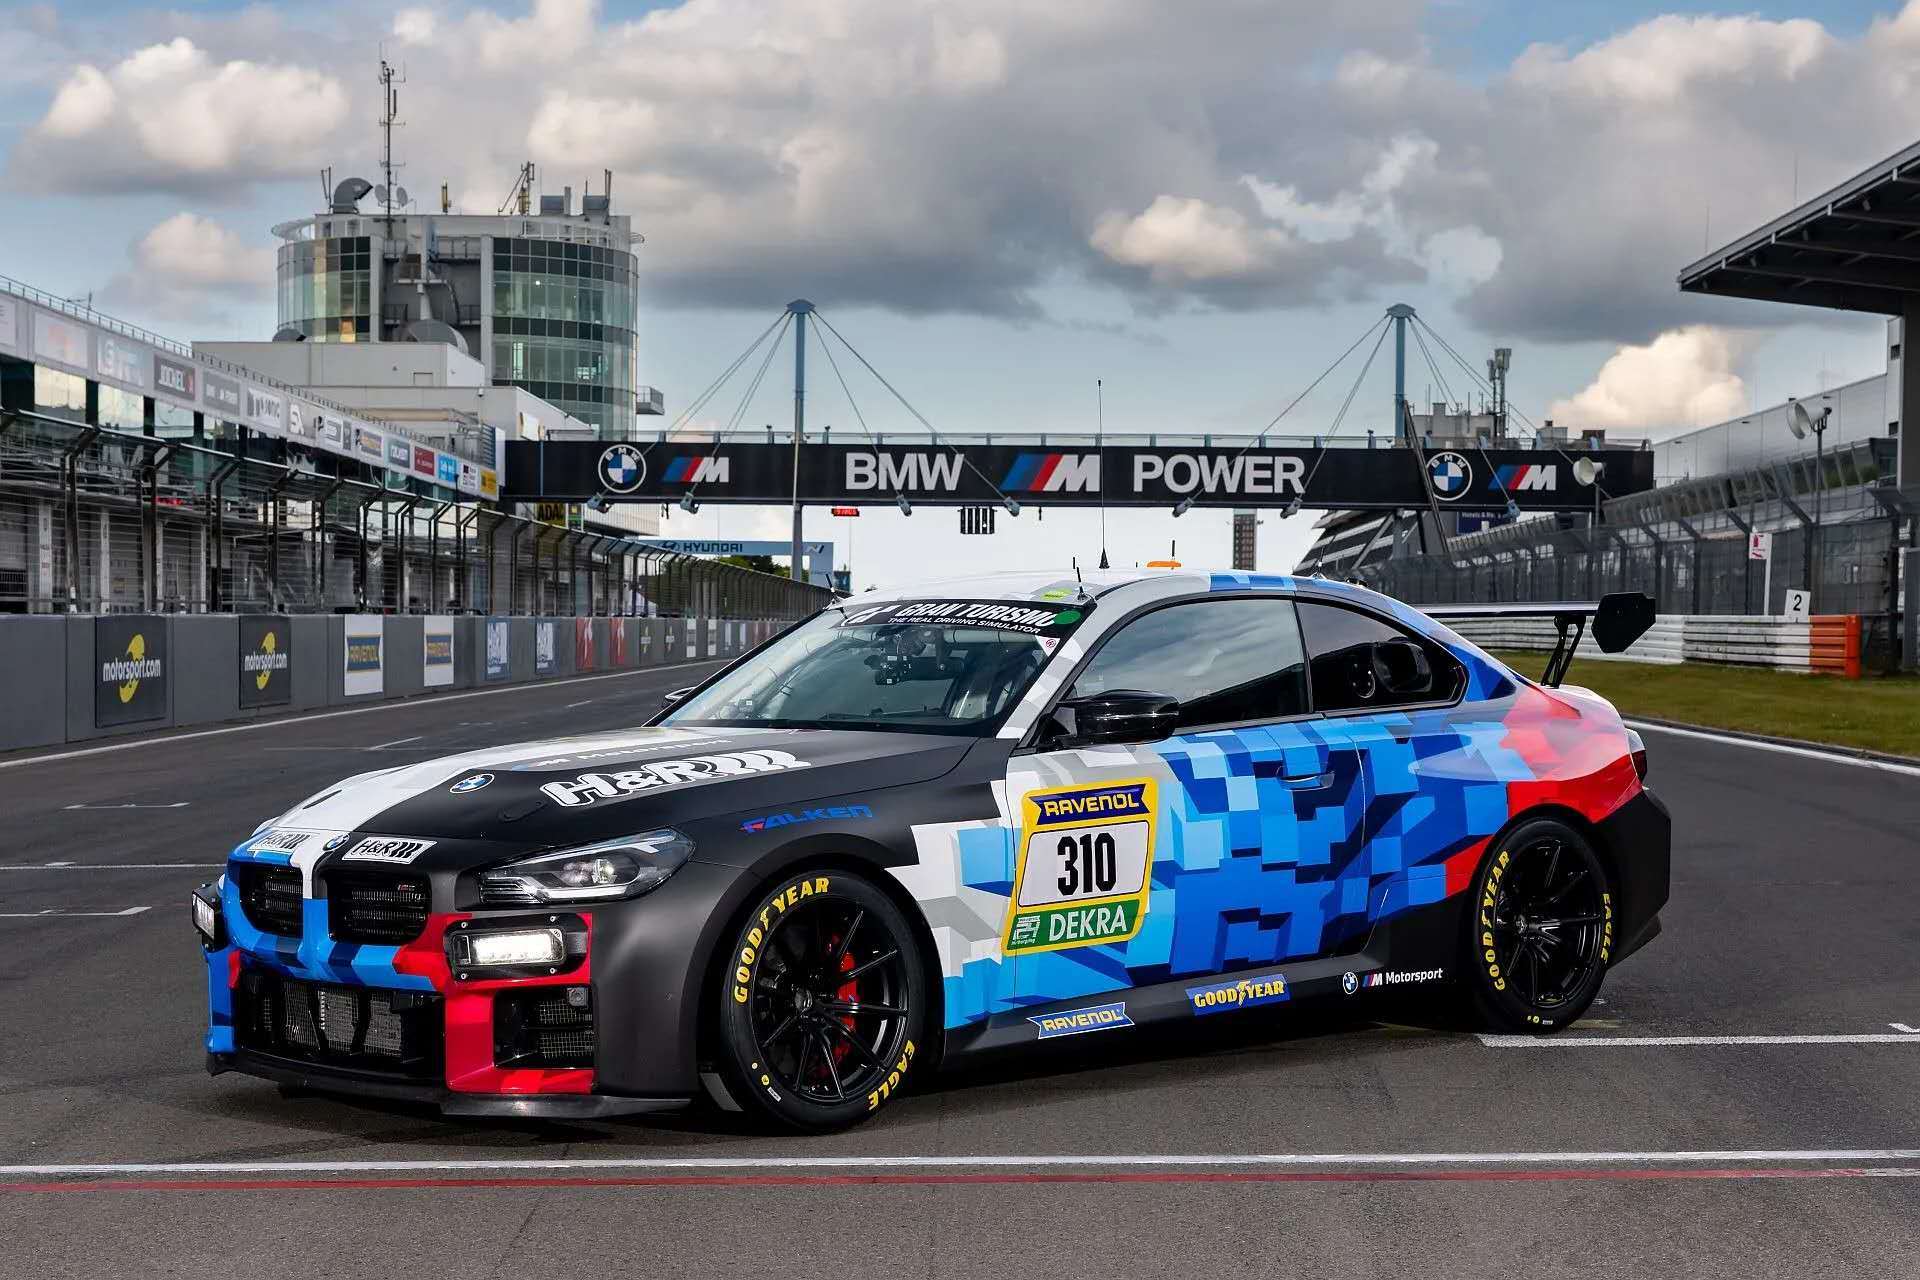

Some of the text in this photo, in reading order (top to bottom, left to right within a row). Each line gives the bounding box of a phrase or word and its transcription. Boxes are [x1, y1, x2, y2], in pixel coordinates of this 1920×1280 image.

[846, 453, 965, 490] BMW
[1133, 454, 1305, 494] POWER
[683, 543, 743, 553] HYUNDAI
[897, 603, 959, 617] GRAN
[1793, 594, 1802, 611] 2
[932, 618, 977, 626] DRIVING
[979, 620, 1041, 634] SIMULATOR
[103, 657, 161, 684] motorsport.com
[244, 652, 288, 673] motorsport.com
[539, 754, 750, 807] H&R
[1044, 793, 1140, 817] RAVENOL
[738, 805, 873, 833] FALKEN
[351, 841, 405, 859] H&R
[1057, 832, 1117, 896] 310
[1049, 904, 1127, 942] DEKRA
[1601, 893, 1612, 965] EAGLE
[1386, 967, 1443, 984] Motorsport
[1041, 1010, 1122, 1032] RAVENOL
[868, 1039, 915, 1111] EAGLE
